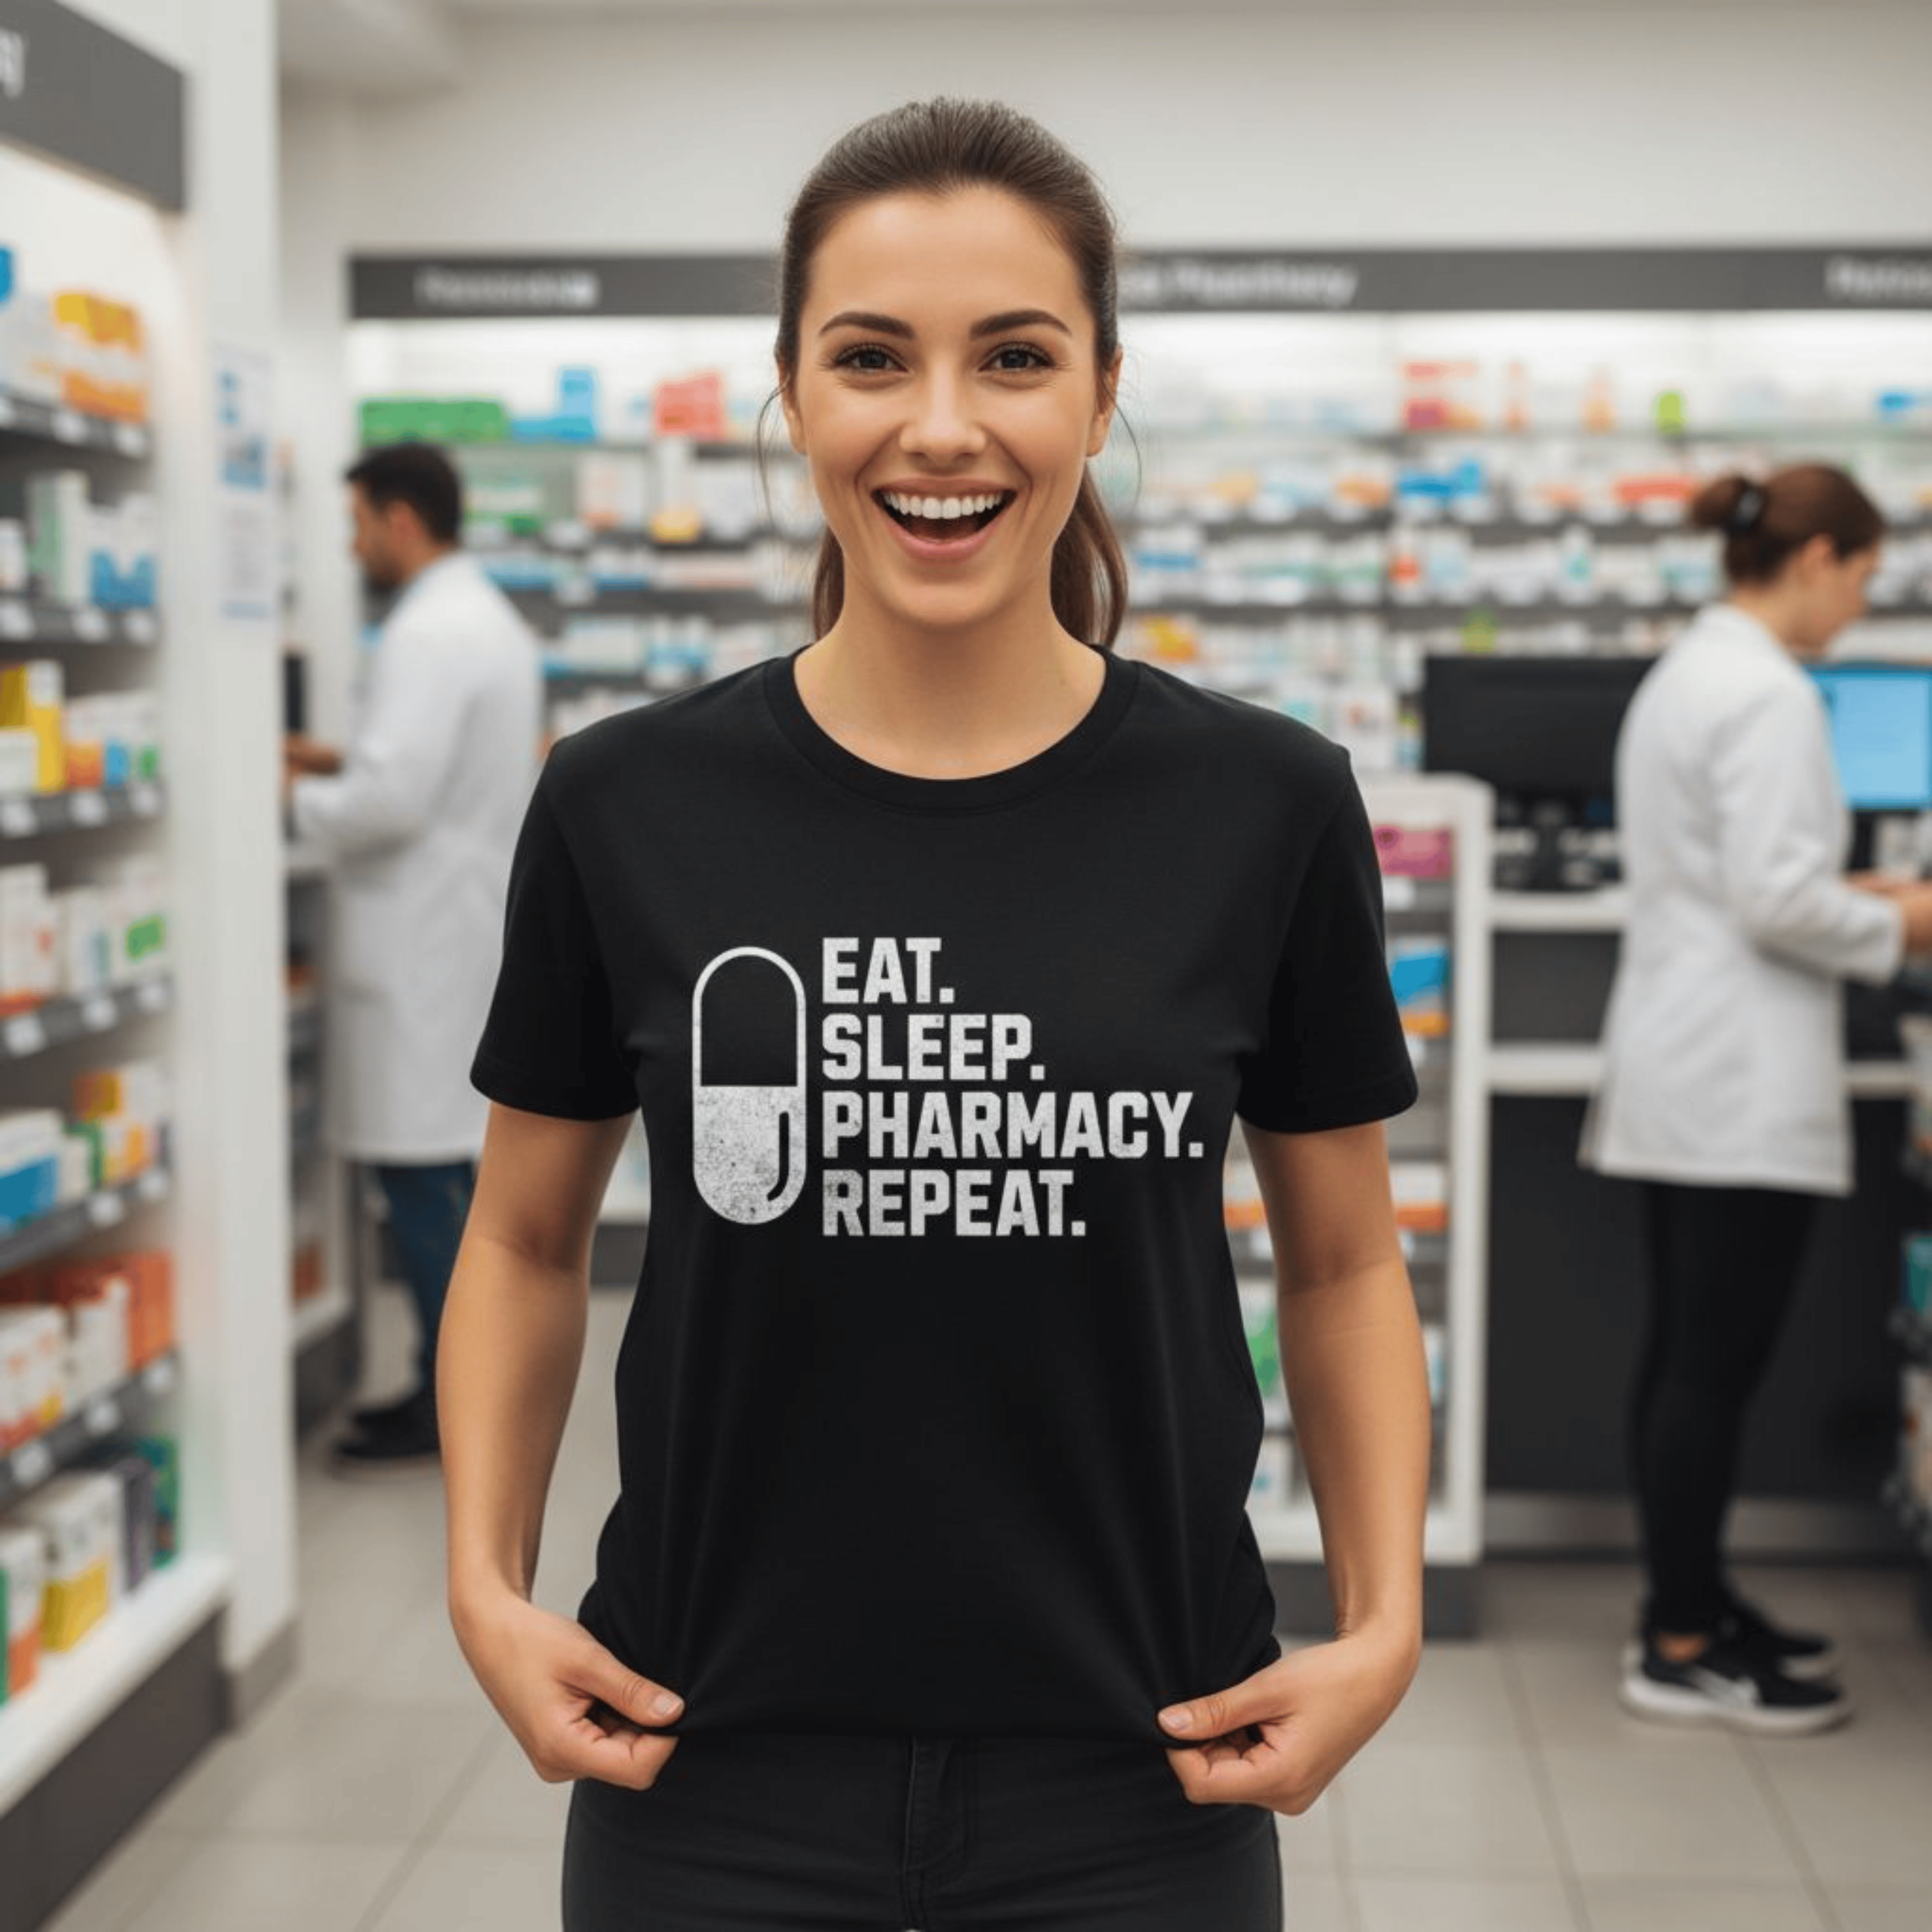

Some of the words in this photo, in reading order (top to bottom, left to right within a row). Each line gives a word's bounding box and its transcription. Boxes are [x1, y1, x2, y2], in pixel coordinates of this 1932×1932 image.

[822, 937, 954, 1004] EAT.
[822, 1013, 1044, 1080] SLEEP.
[822, 1091, 1203, 1158] PHARMACY.
[822, 1169, 1085, 1236] REPEAT.
